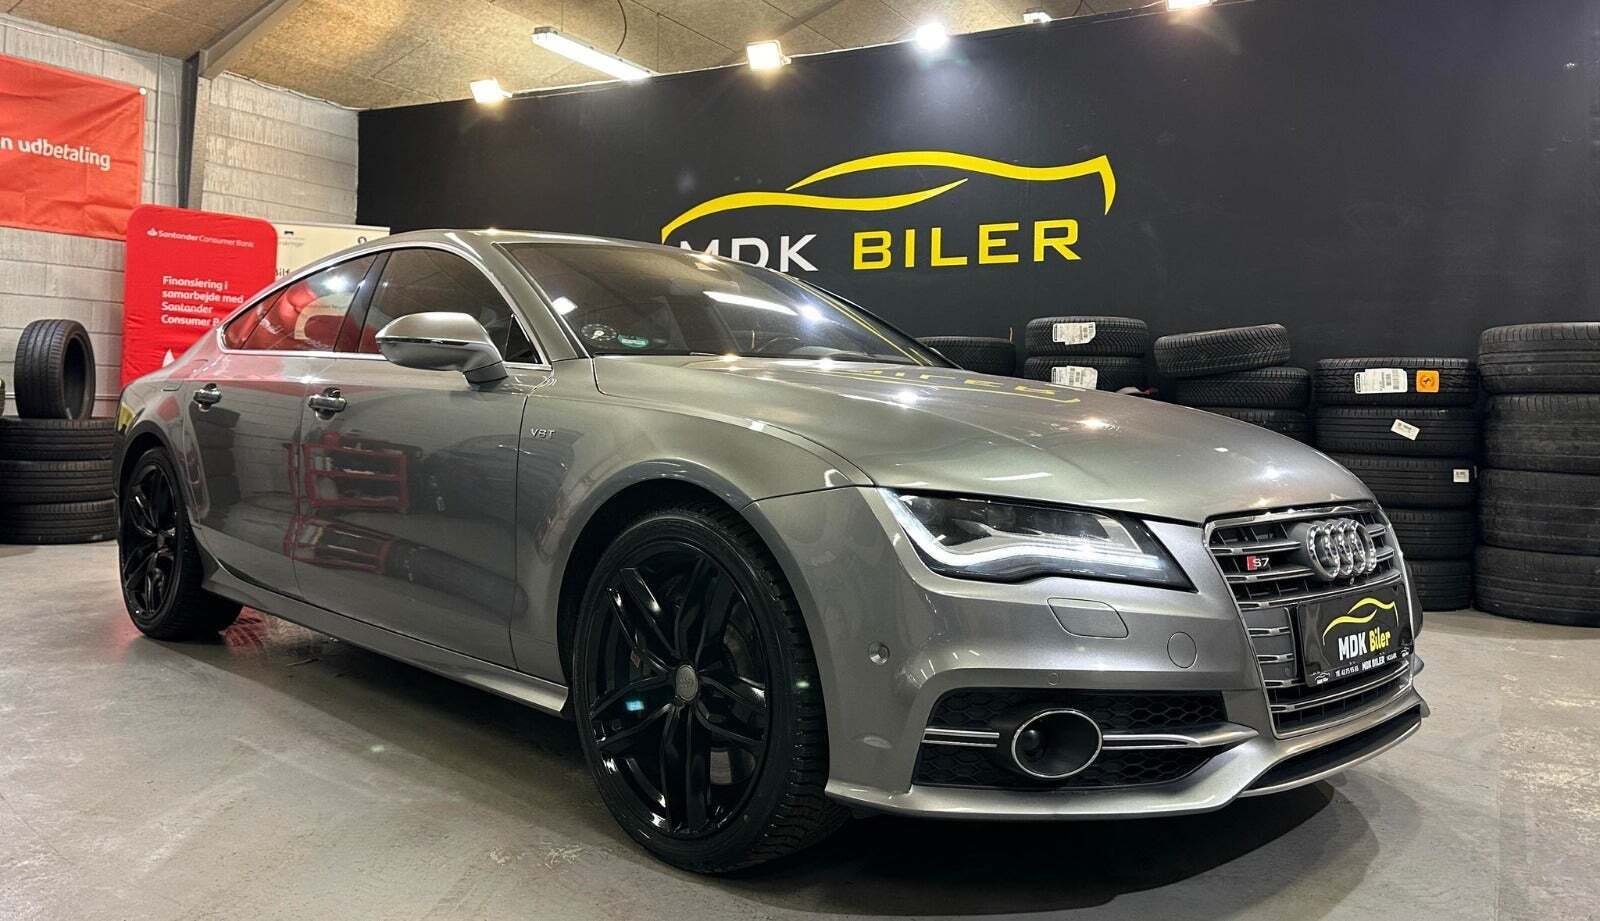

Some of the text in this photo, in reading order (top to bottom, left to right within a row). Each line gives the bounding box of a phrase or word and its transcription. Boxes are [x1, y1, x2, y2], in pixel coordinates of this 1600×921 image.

[18, 138, 111, 171] udbetaling
[158, 230, 254, 248] Santander Consumer Bank
[853, 218, 1082, 271] BILER
[162, 275, 223, 292] Finansiering
[162, 290, 244, 304] samarbejde med
[161, 301, 214, 314] Santander
[161, 314, 210, 326] Consumer
[1338, 626, 1391, 661] MDK Biler
